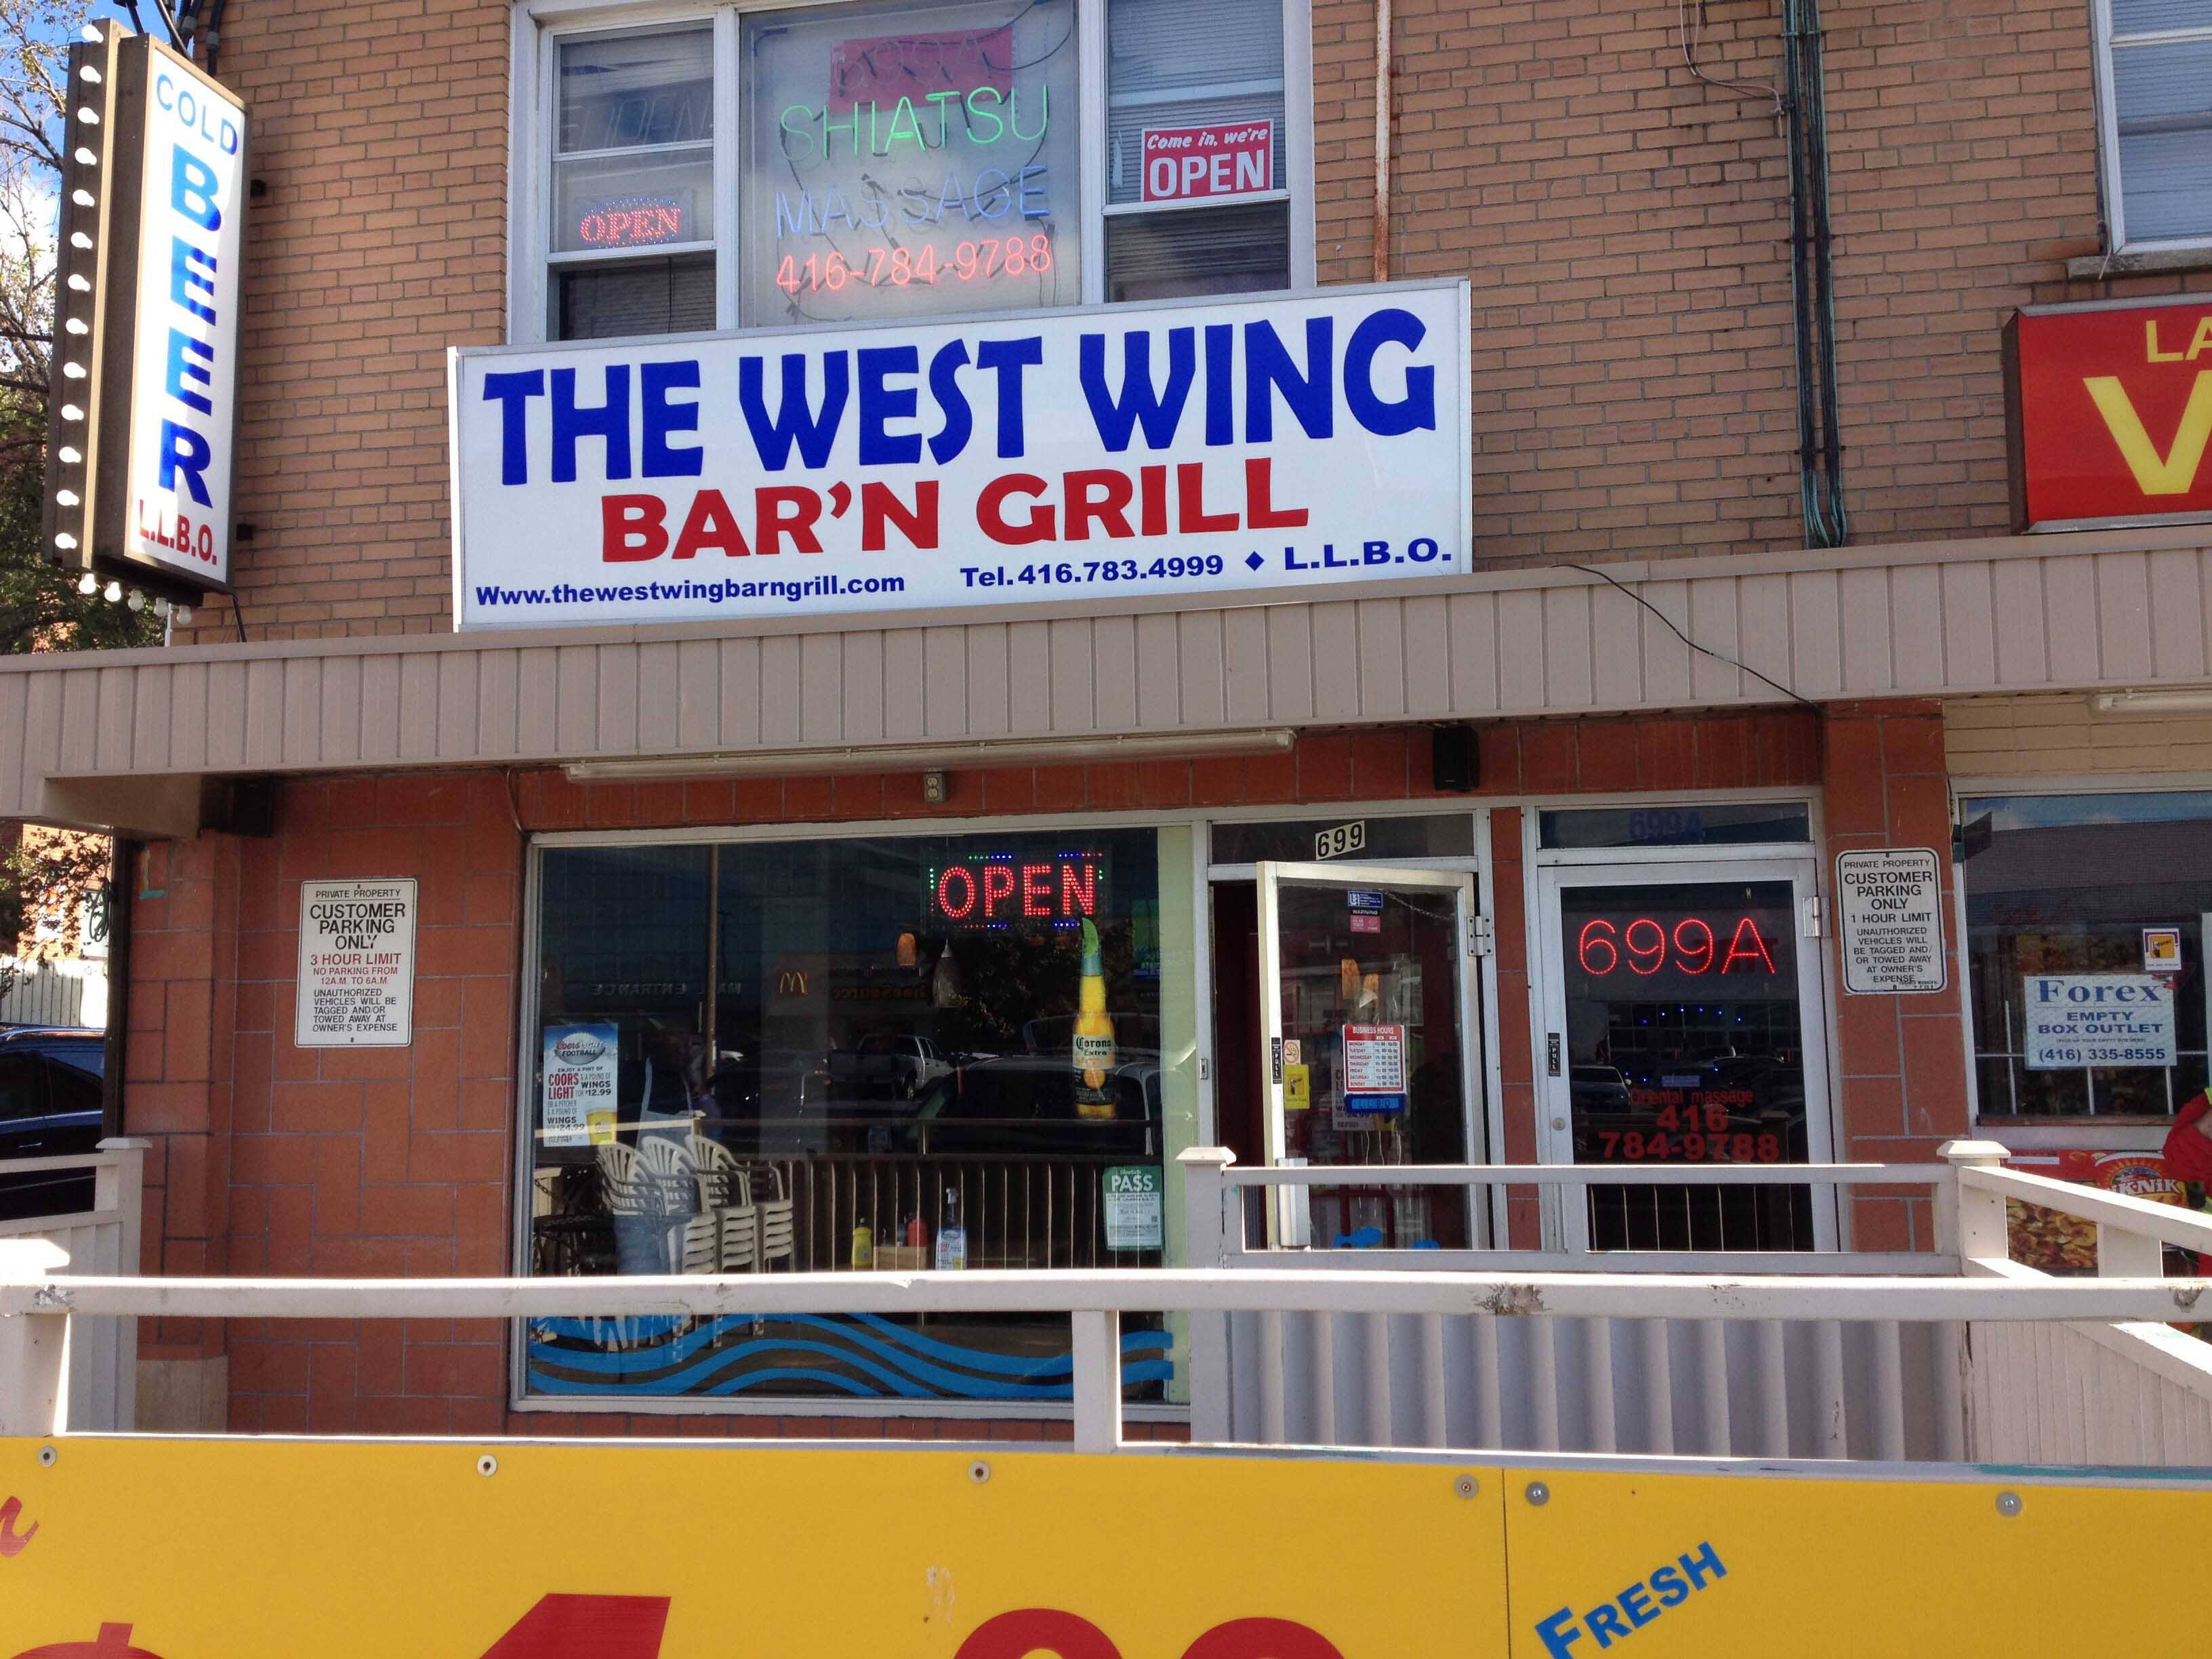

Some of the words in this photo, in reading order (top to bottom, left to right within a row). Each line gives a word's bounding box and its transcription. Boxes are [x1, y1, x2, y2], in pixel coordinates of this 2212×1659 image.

[157, 73, 237, 156] COLD
[779, 85, 1048, 161] SHIATSU
[1147, 134, 1191, 150] Come
[1198, 131, 1218, 147] in,
[1224, 127, 1268, 144] we're
[1149, 149, 1265, 197] OPEN
[776, 165, 1049, 239] MASSAGE
[579, 206, 681, 245] OPEN
[777, 233, 1052, 294] 416-784-9788
[159, 142, 222, 509] BEER
[483, 360, 704, 486] THE
[739, 336, 1042, 472] WEST
[1080, 308, 1436, 452] WING
[601, 480, 939, 562] BAR'N
[976, 457, 1309, 546] GRILL
[1284, 537, 1452, 571] L.L.B.O.
[476, 574, 905, 606] Www.thewestwingbarngrill.com
[1317, 825, 1363, 858] 699
[1844, 861, 1879, 869] PRIVATE
[1883, 859, 1930, 867] PROPERTY
[1844, 872, 1932, 884] CUSTOMER
[316, 890, 350, 898] PRIVATE
[354, 889, 401, 898] PROPERTY
[938, 865, 1095, 918] OPEN
[1857, 884, 1921, 897] PARKING
[310, 903, 406, 919] CUSTOMER
[1871, 898, 1908, 910] ONLY
[1850, 915, 1856, 923] 1
[1863, 914, 1896, 923] HOUR
[1902, 913, 1931, 922] LIMIT
[319, 919, 394, 935] PARKING
[1857, 927, 1927, 936] UNAUTHORIZED
[335, 935, 378, 949] ONLY
[1579, 917, 1776, 975] 699A
[1858, 937, 1902, 945] VEHICLES
[310, 954, 318, 965] 3
[322, 954, 361, 965] HOUR
[366, 953, 402, 964] LIMIT
[1870, 947, 1905, 955] TAGGED
[313, 968, 326, 976] NO
[329, 967, 369, 975] PARKING
[1881, 964, 1923, 972] OWNER'S
[352, 977, 363, 985] TO
[2035, 980, 2161, 1002] Forex
[314, 998, 356, 1006] VEHICLES
[314, 1006, 348, 1015] TAGGED
[352, 1006, 386, 1014] AND/OR
[2067, 1012, 2133, 1021] EMPTY
[312, 1024, 352, 1032] OWNER'S
[356, 1023, 397, 1031] EXPENSE
[2039, 1025, 2078, 1033] BOX
[2085, 1023, 2163, 1033] OUTLET
[2039, 1050, 2081, 1063] (416)
[2089, 1048, 2165, 1060] 335-8555
[548, 1073, 579, 1086] COORS
[548, 1087, 575, 1100] LIGHT
[1629, 1088, 1684, 1104] Oriental
[1692, 1090, 1753, 1106] massage
[1656, 1105, 1729, 1132] 416
[1598, 1131, 1780, 1161] 784-9788
[1111, 1174, 1153, 1192] PASS
[1536, 1540, 1727, 1659] FRESH
